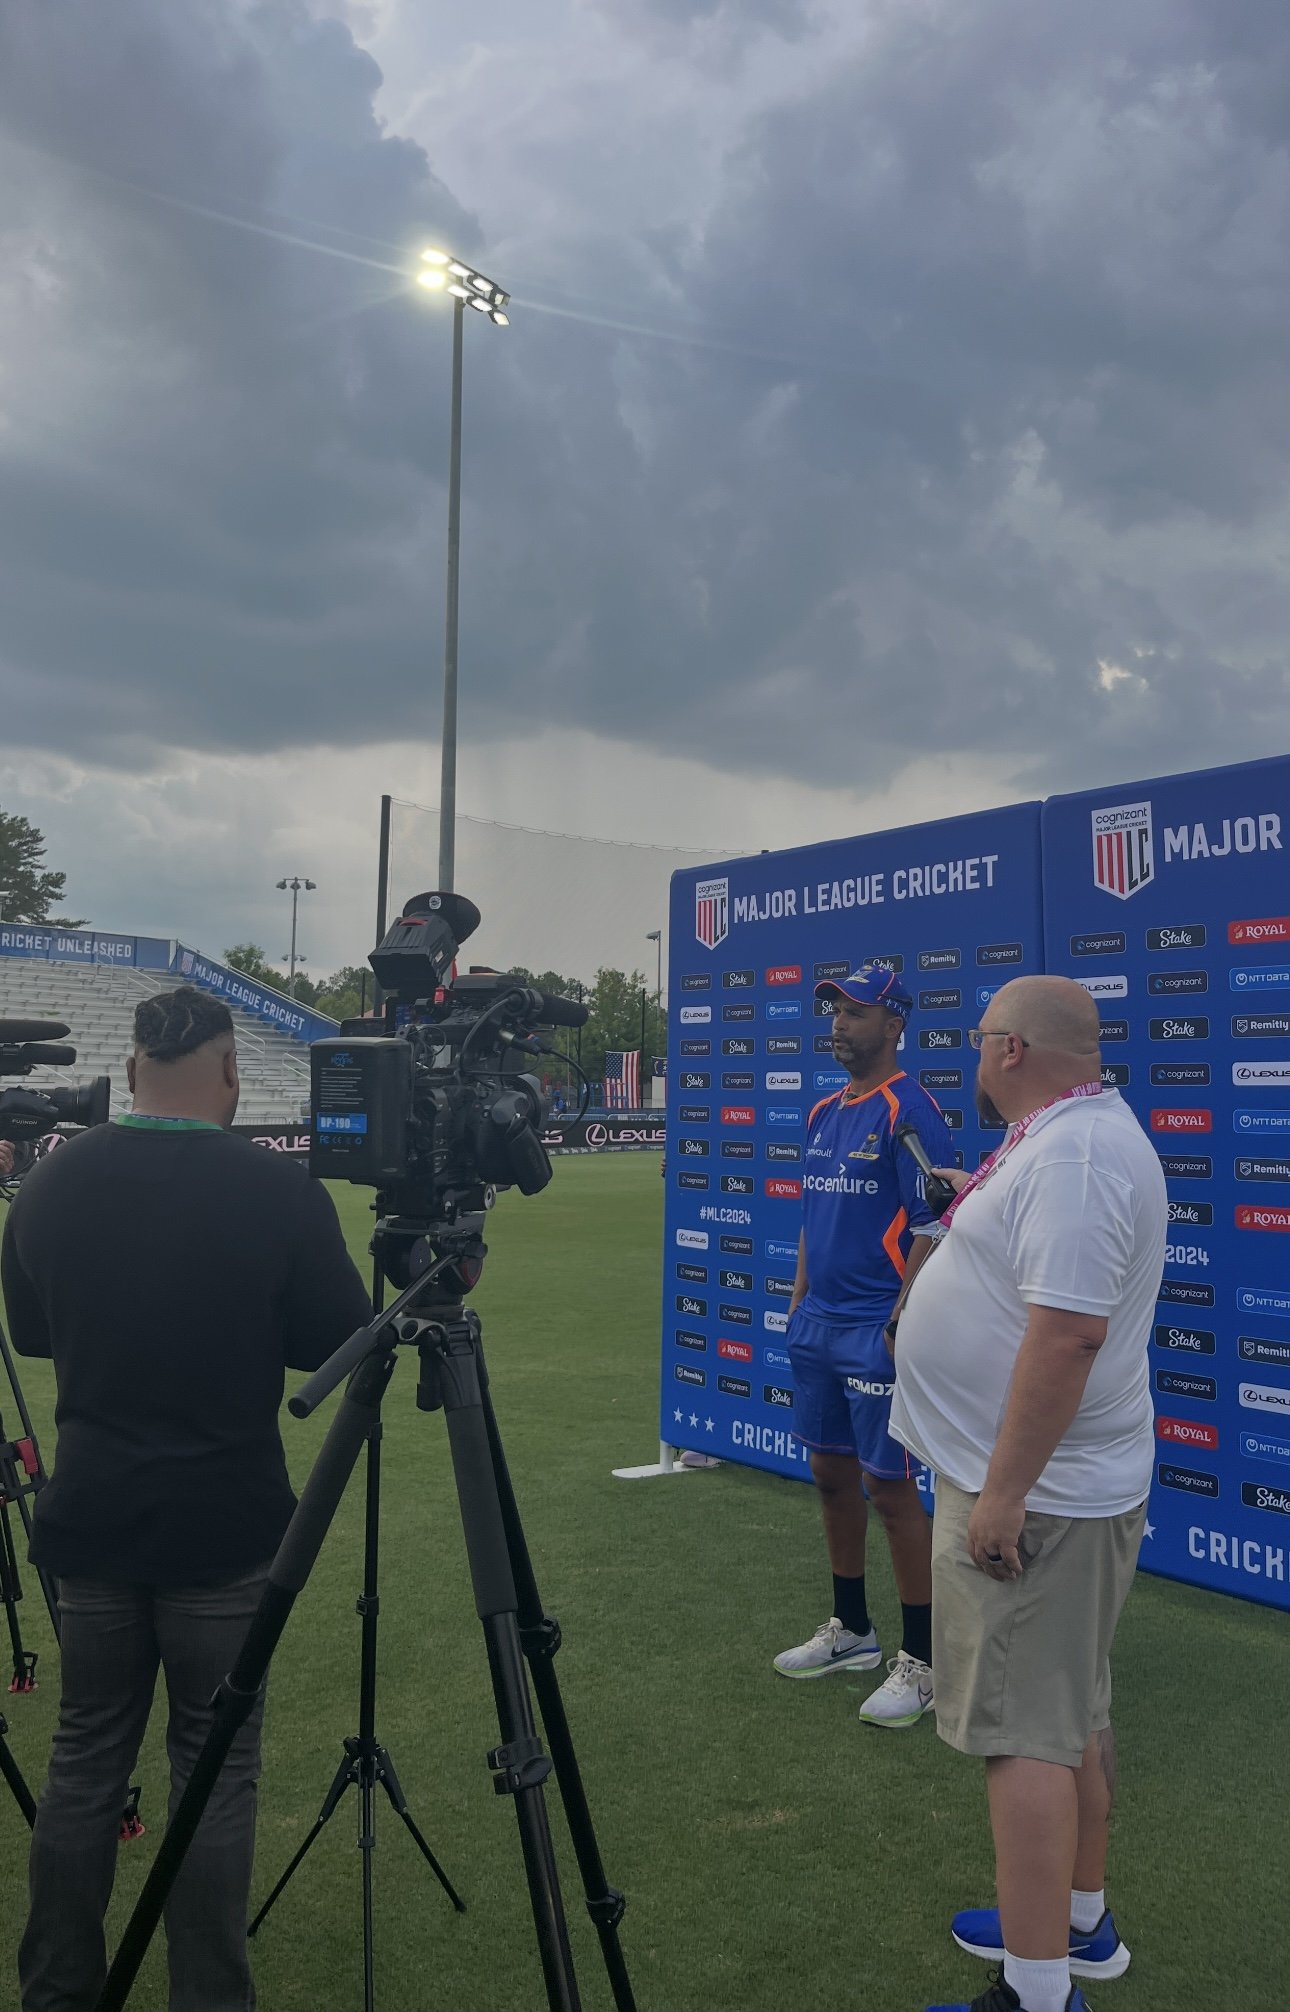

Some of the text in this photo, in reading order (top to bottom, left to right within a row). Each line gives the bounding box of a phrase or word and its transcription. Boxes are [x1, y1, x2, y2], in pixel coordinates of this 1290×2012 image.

[1095, 807, 1148, 825] cognizant
[1163, 813, 1283, 862] MAJOR
[734, 854, 998, 924] MAJOR LEAGUE CRICKET
[1245, 924, 1287, 939] ROYAL
[1085, 938, 1121, 949] cognizant
[1159, 929, 1192, 948] Stake
[1, 933, 132, 958] RICKET UNLEASHED
[930, 954, 956, 965] Remitly
[988, 949, 1018, 960] cognizant
[775, 971, 797, 982] ROYAL
[823, 966, 847, 976] cognizant
[729, 973, 747, 986] Stake
[1164, 977, 1202, 989] cognizant
[1248, 974, 1265, 983] NTT
[1088, 983, 1124, 992] LEXUS
[194, 962, 305, 1031] MAJOR LEAGUE CRICKET
[930, 994, 957, 1004] cognizant
[1099, 1026, 1123, 1036] gnizant
[1162, 1020, 1194, 1038] Stake
[1250, 1019, 1289, 1031] Remitly
[776, 1041, 797, 1050] Remitly
[928, 1031, 952, 1047] Stake
[729, 1040, 747, 1053] Stake
[931, 1074, 958, 1083] cognizant
[1100, 1068, 1116, 1083] ake
[1166, 1069, 1204, 1079] cognizant
[1252, 1070, 1290, 1078] LEXUS
[686, 1075, 704, 1088] Stake
[729, 1110, 750, 1121] ROYAL
[1167, 1115, 1204, 1129] ROYAL
[1252, 1117, 1269, 1125] NTT
[609, 1129, 666, 1142] LEXUS
[250, 1135, 311, 1151] EXUS
[685, 1141, 703, 1155] Stake
[1168, 1161, 1207, 1172] cognizant
[727, 1178, 746, 1192] Stake
[775, 1183, 798, 1195] ROYAL
[700, 1206, 751, 1225] #MLC2024
[1167, 1203, 1199, 1221] Stake
[1165, 1245, 1210, 1266] 2024
[726, 1272, 745, 1288] Stake
[1170, 1288, 1208, 1300] cognizant
[682, 1298, 701, 1314] Stake
[1256, 1297, 1274, 1307] NTT
[1168, 1329, 1201, 1349] Stake
[727, 1344, 749, 1357] ROYAL
[1257, 1344, 1290, 1358] Remitl
[1172, 1378, 1211, 1392] cognizant
[771, 1387, 791, 1405] Stake
[1258, 1393, 1290, 1406] LEXU
[1173, 1424, 1212, 1443] ROYAL
[1259, 1442, 1277, 1454] NTT
[1175, 1475, 1213, 1490] cognizant
[1256, 1487, 1290, 1513] Stake
[1188, 1526, 1290, 1582] CRICK
